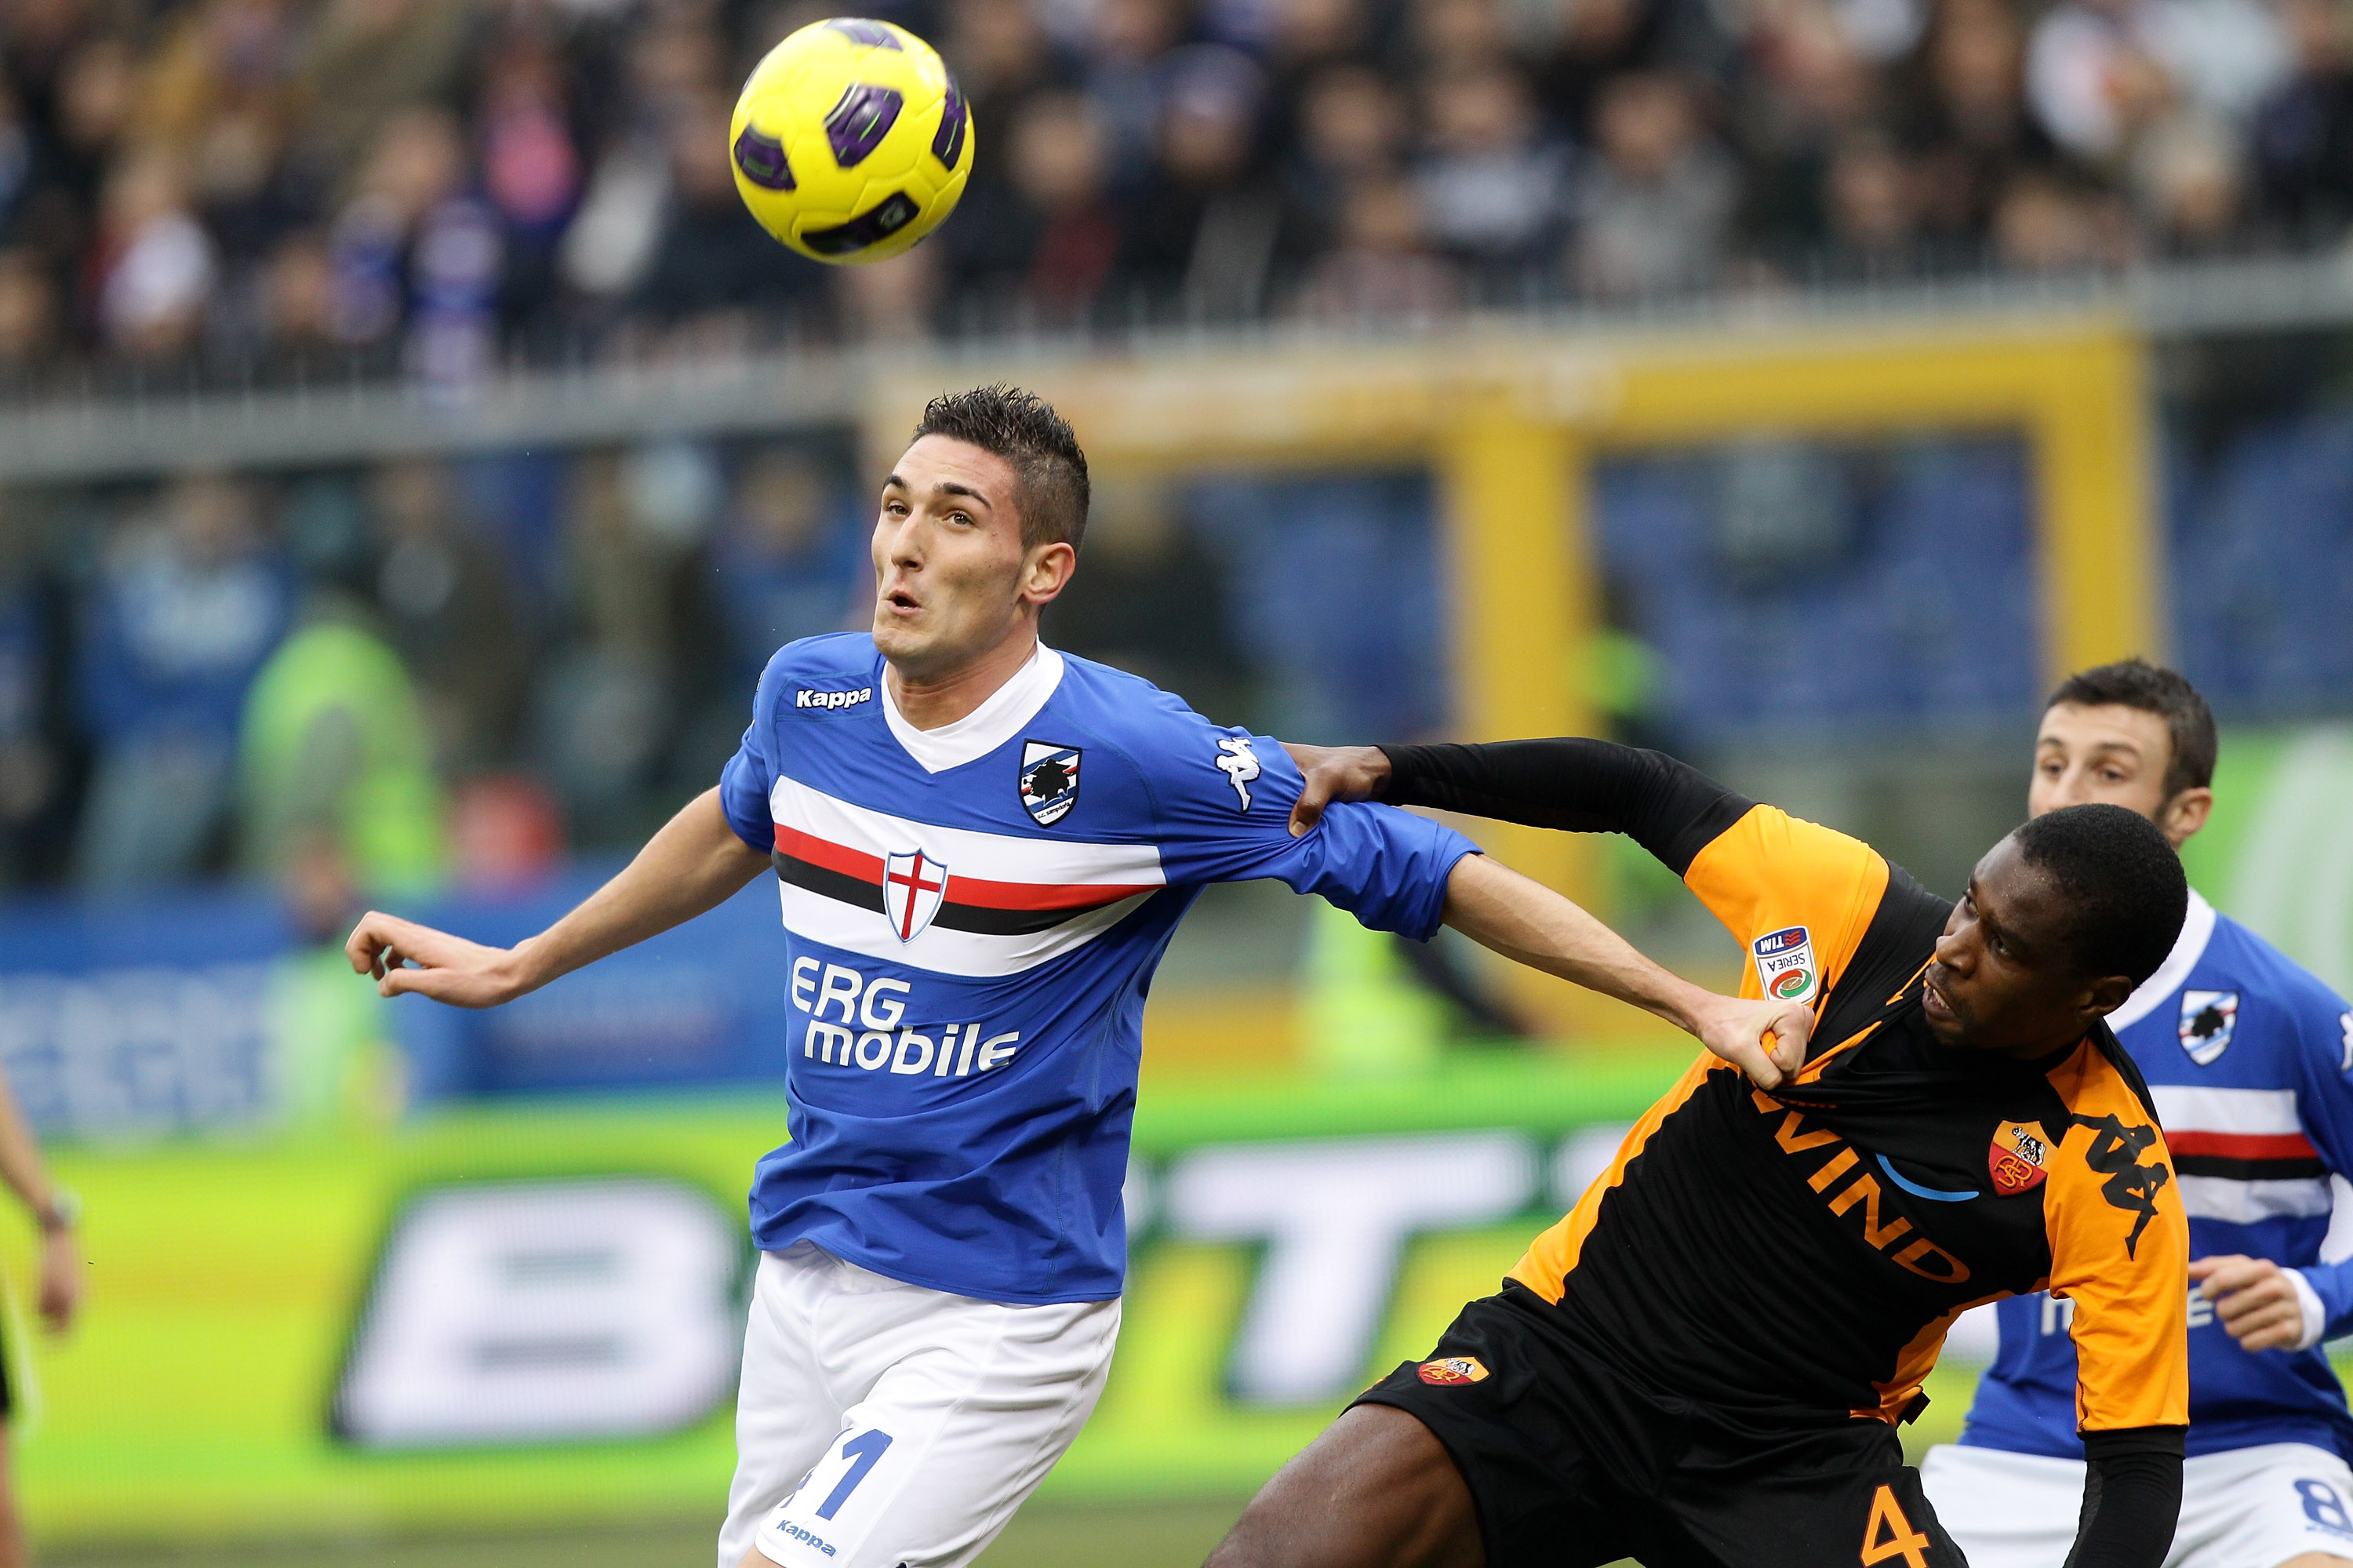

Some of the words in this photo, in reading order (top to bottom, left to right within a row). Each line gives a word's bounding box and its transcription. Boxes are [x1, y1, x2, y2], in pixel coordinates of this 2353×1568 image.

[795, 688, 871, 709] Kappa
[1760, 935, 1784, 952] TIM
[1777, 952, 1806, 970] SERIE
[1767, 960, 1776, 972] A
[791, 956, 911, 1032] ERG
[804, 1023, 1020, 1077] mobile
[1860, 1483, 1932, 1568] 4
[2294, 1479, 2353, 1534] 8
[776, 1520, 837, 1559] Kappa
